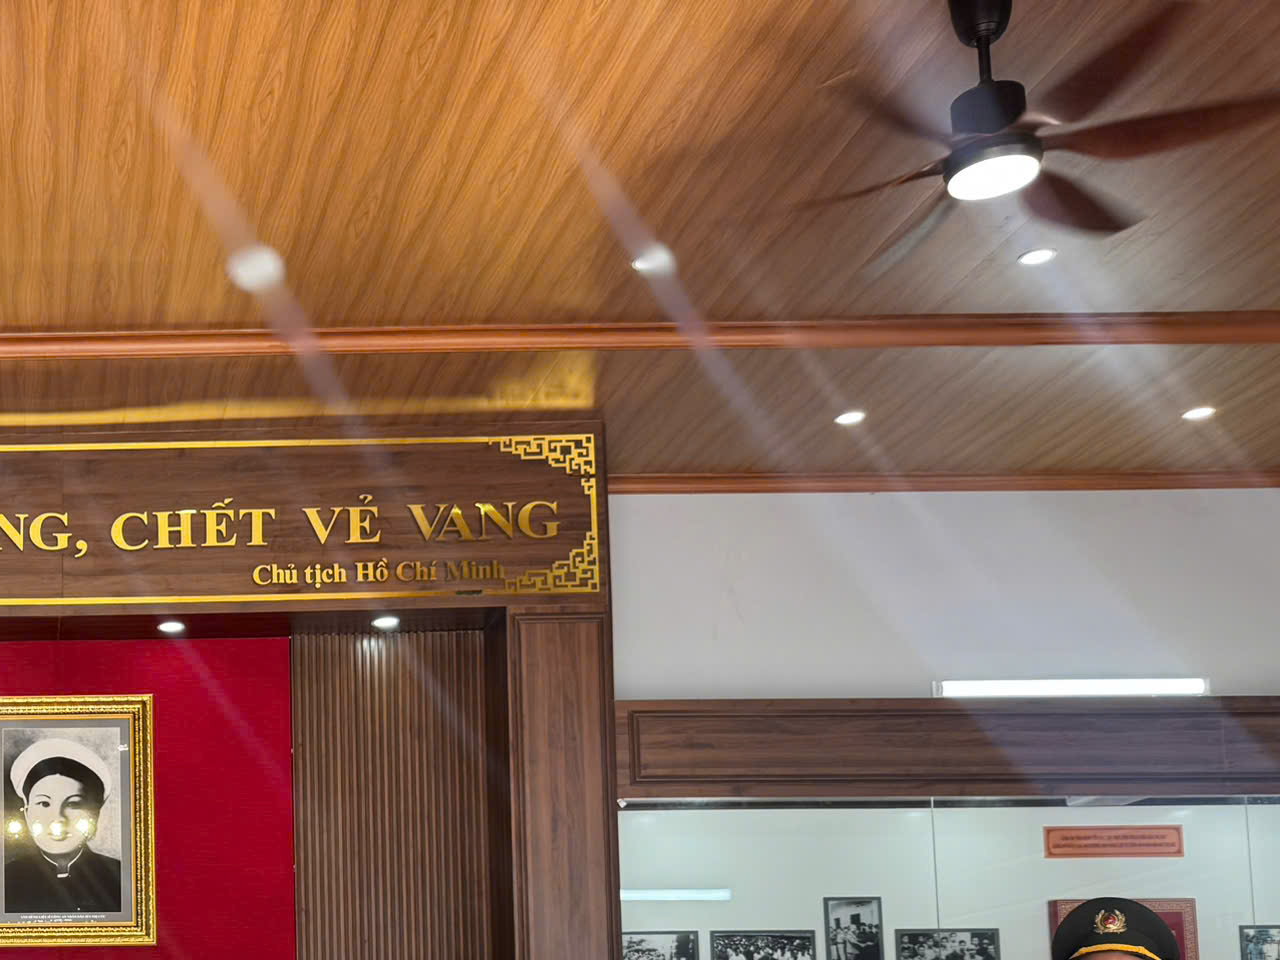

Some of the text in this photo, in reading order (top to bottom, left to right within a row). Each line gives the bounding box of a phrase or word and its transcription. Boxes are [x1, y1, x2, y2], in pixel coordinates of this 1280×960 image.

[110, 497, 276, 552] CHẾT
[302, 494, 382, 545] VẺ
[406, 501, 561, 542] VANG
[252, 557, 506, 588] Chủ tịch Hồ Chí Minh
